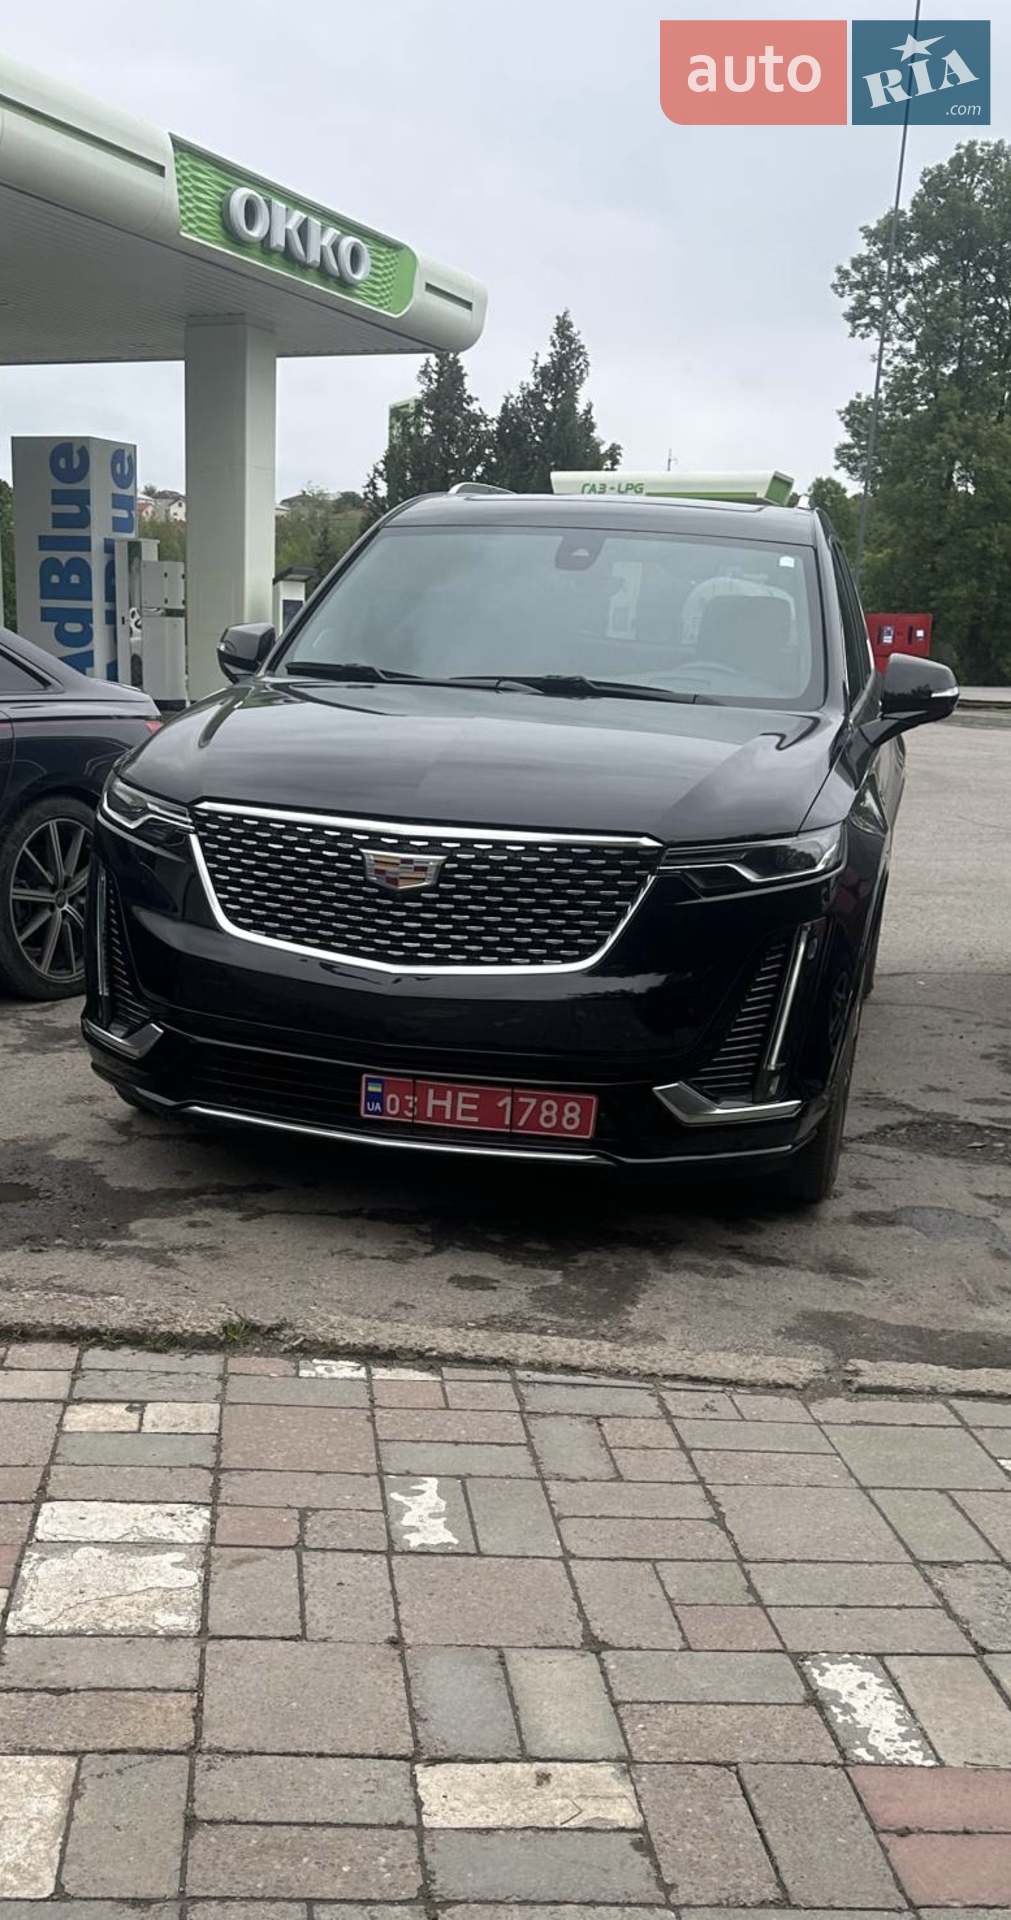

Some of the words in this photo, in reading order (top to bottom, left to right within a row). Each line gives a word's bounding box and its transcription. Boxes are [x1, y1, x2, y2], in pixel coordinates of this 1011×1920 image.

[223, 186, 372, 287] OKKO
[366, 1101, 382, 1112] UA
[385, 1093, 418, 1117] 03
[426, 1088, 480, 1122] HE
[497, 1096, 582, 1130] 1788
